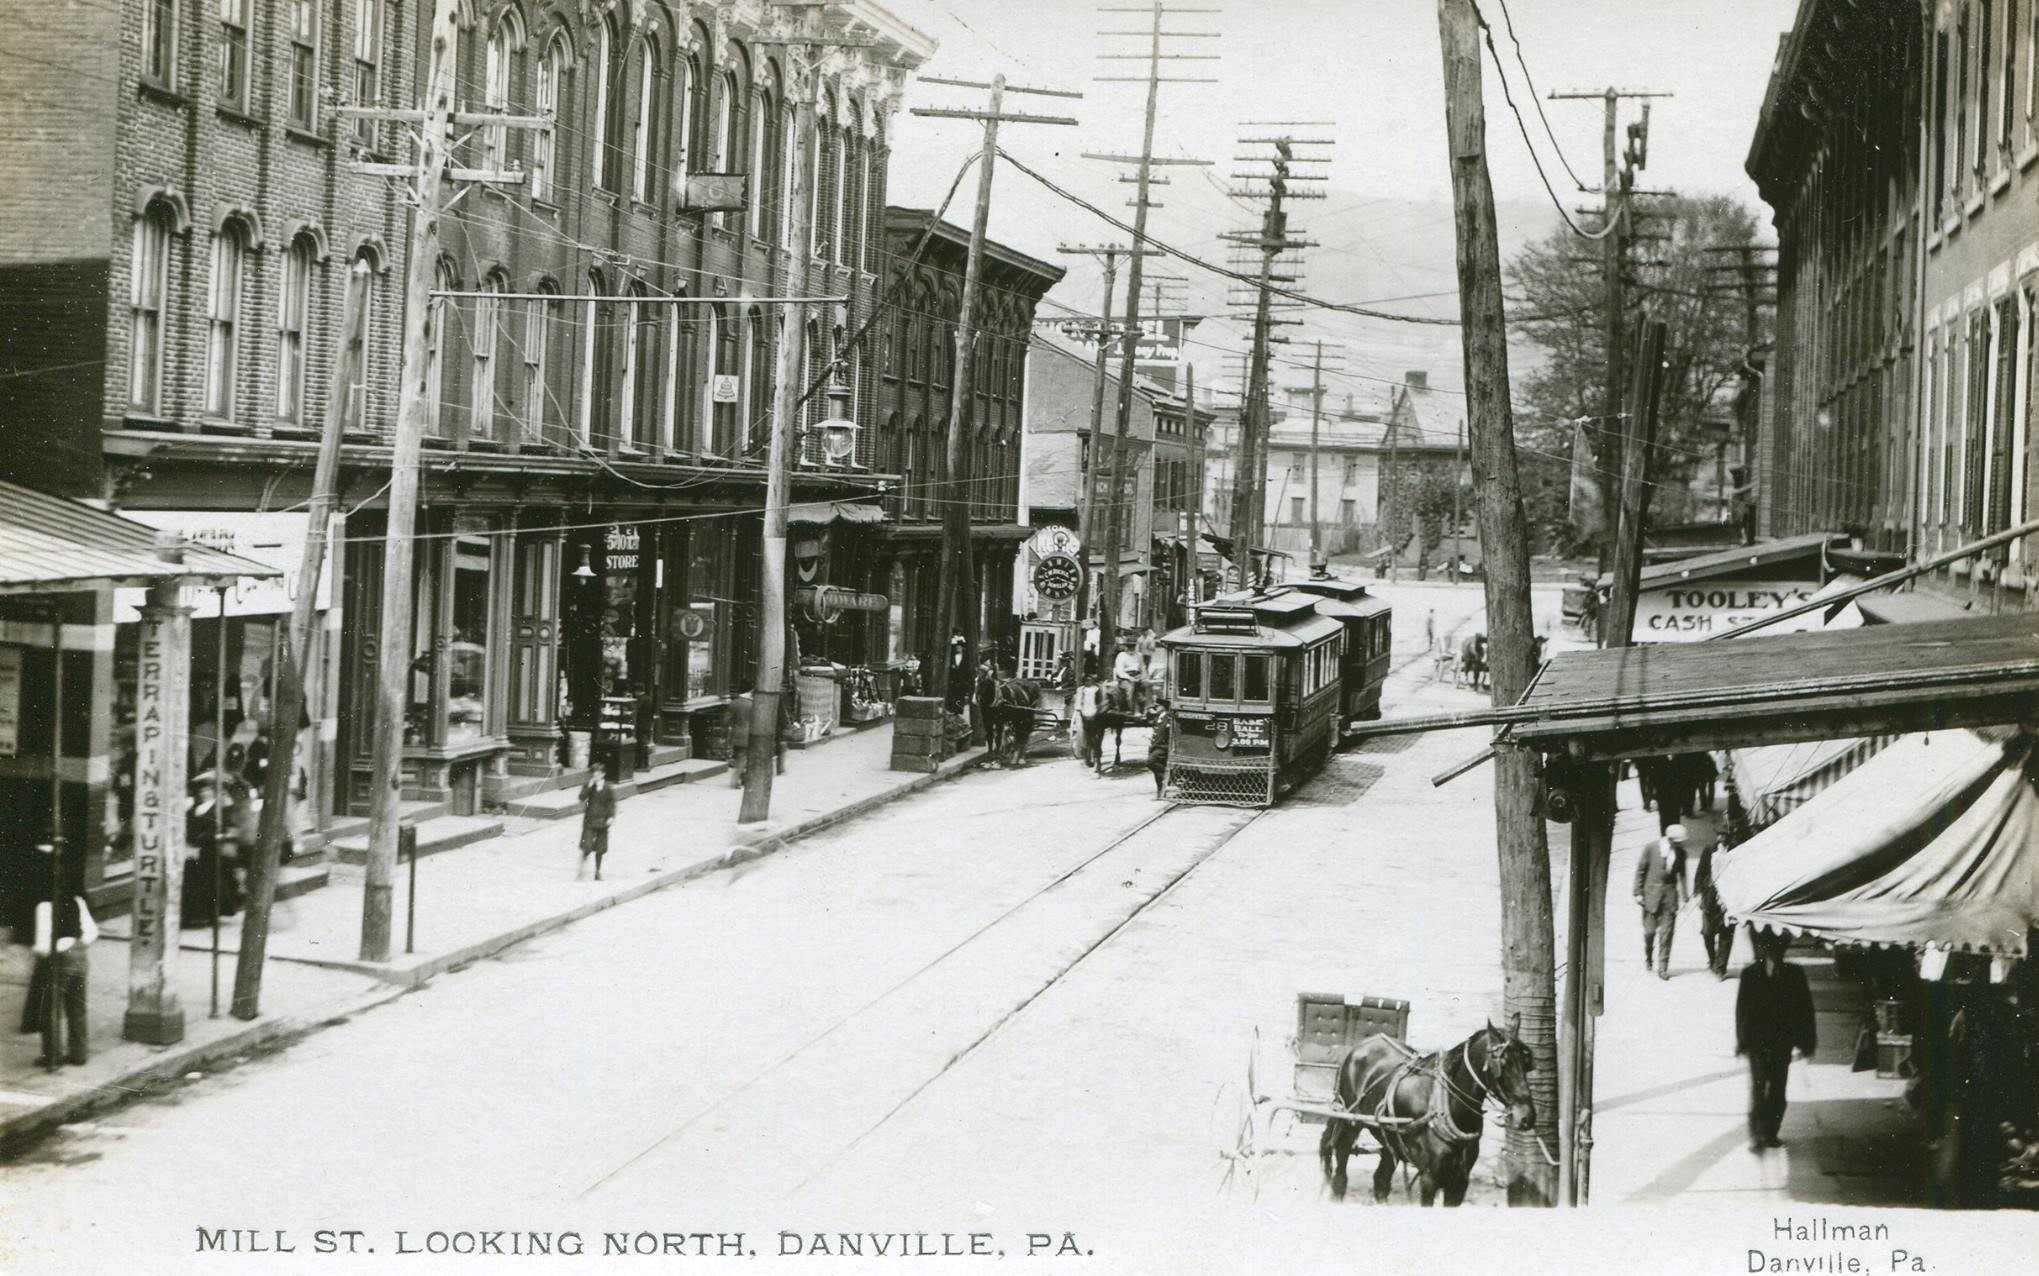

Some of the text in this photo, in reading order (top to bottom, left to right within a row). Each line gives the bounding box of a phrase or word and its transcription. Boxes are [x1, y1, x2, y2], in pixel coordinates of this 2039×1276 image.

[606, 555, 639, 570] STORE
[1665, 588, 1814, 609] TOOLEY'S
[1649, 614, 1712, 631] CASH
[1205, 722, 1228, 732] 28
[1234, 725, 1264, 733] BALL
